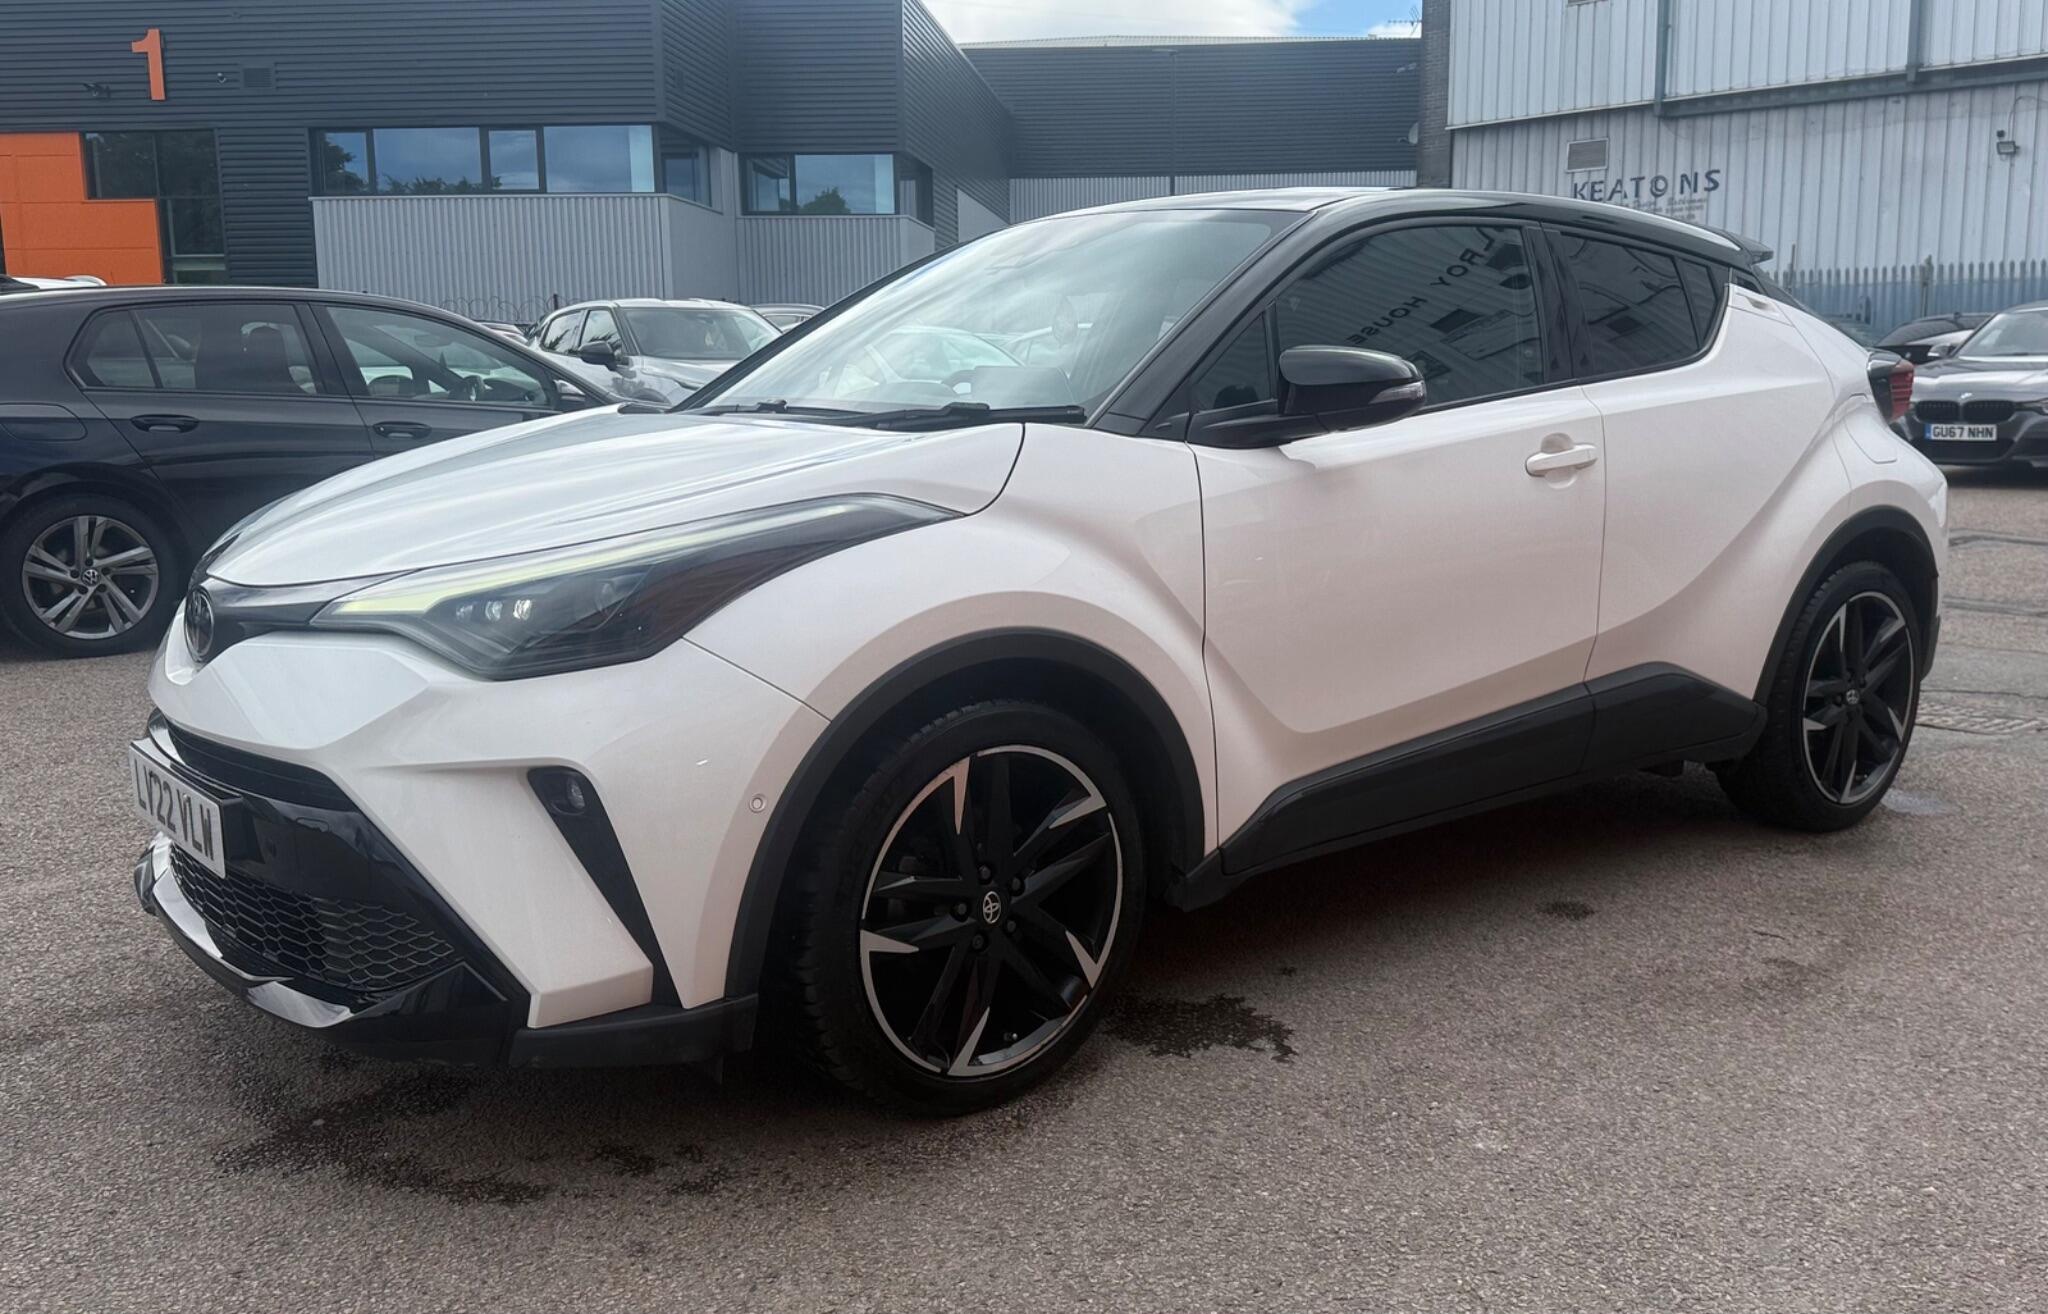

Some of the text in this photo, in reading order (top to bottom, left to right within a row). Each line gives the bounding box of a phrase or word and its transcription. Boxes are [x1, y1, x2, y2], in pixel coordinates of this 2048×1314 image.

[131, 29, 165, 100] 1
[1573, 169, 1721, 202] KEATONS
[1933, 426, 1994, 438] GU67 NHN
